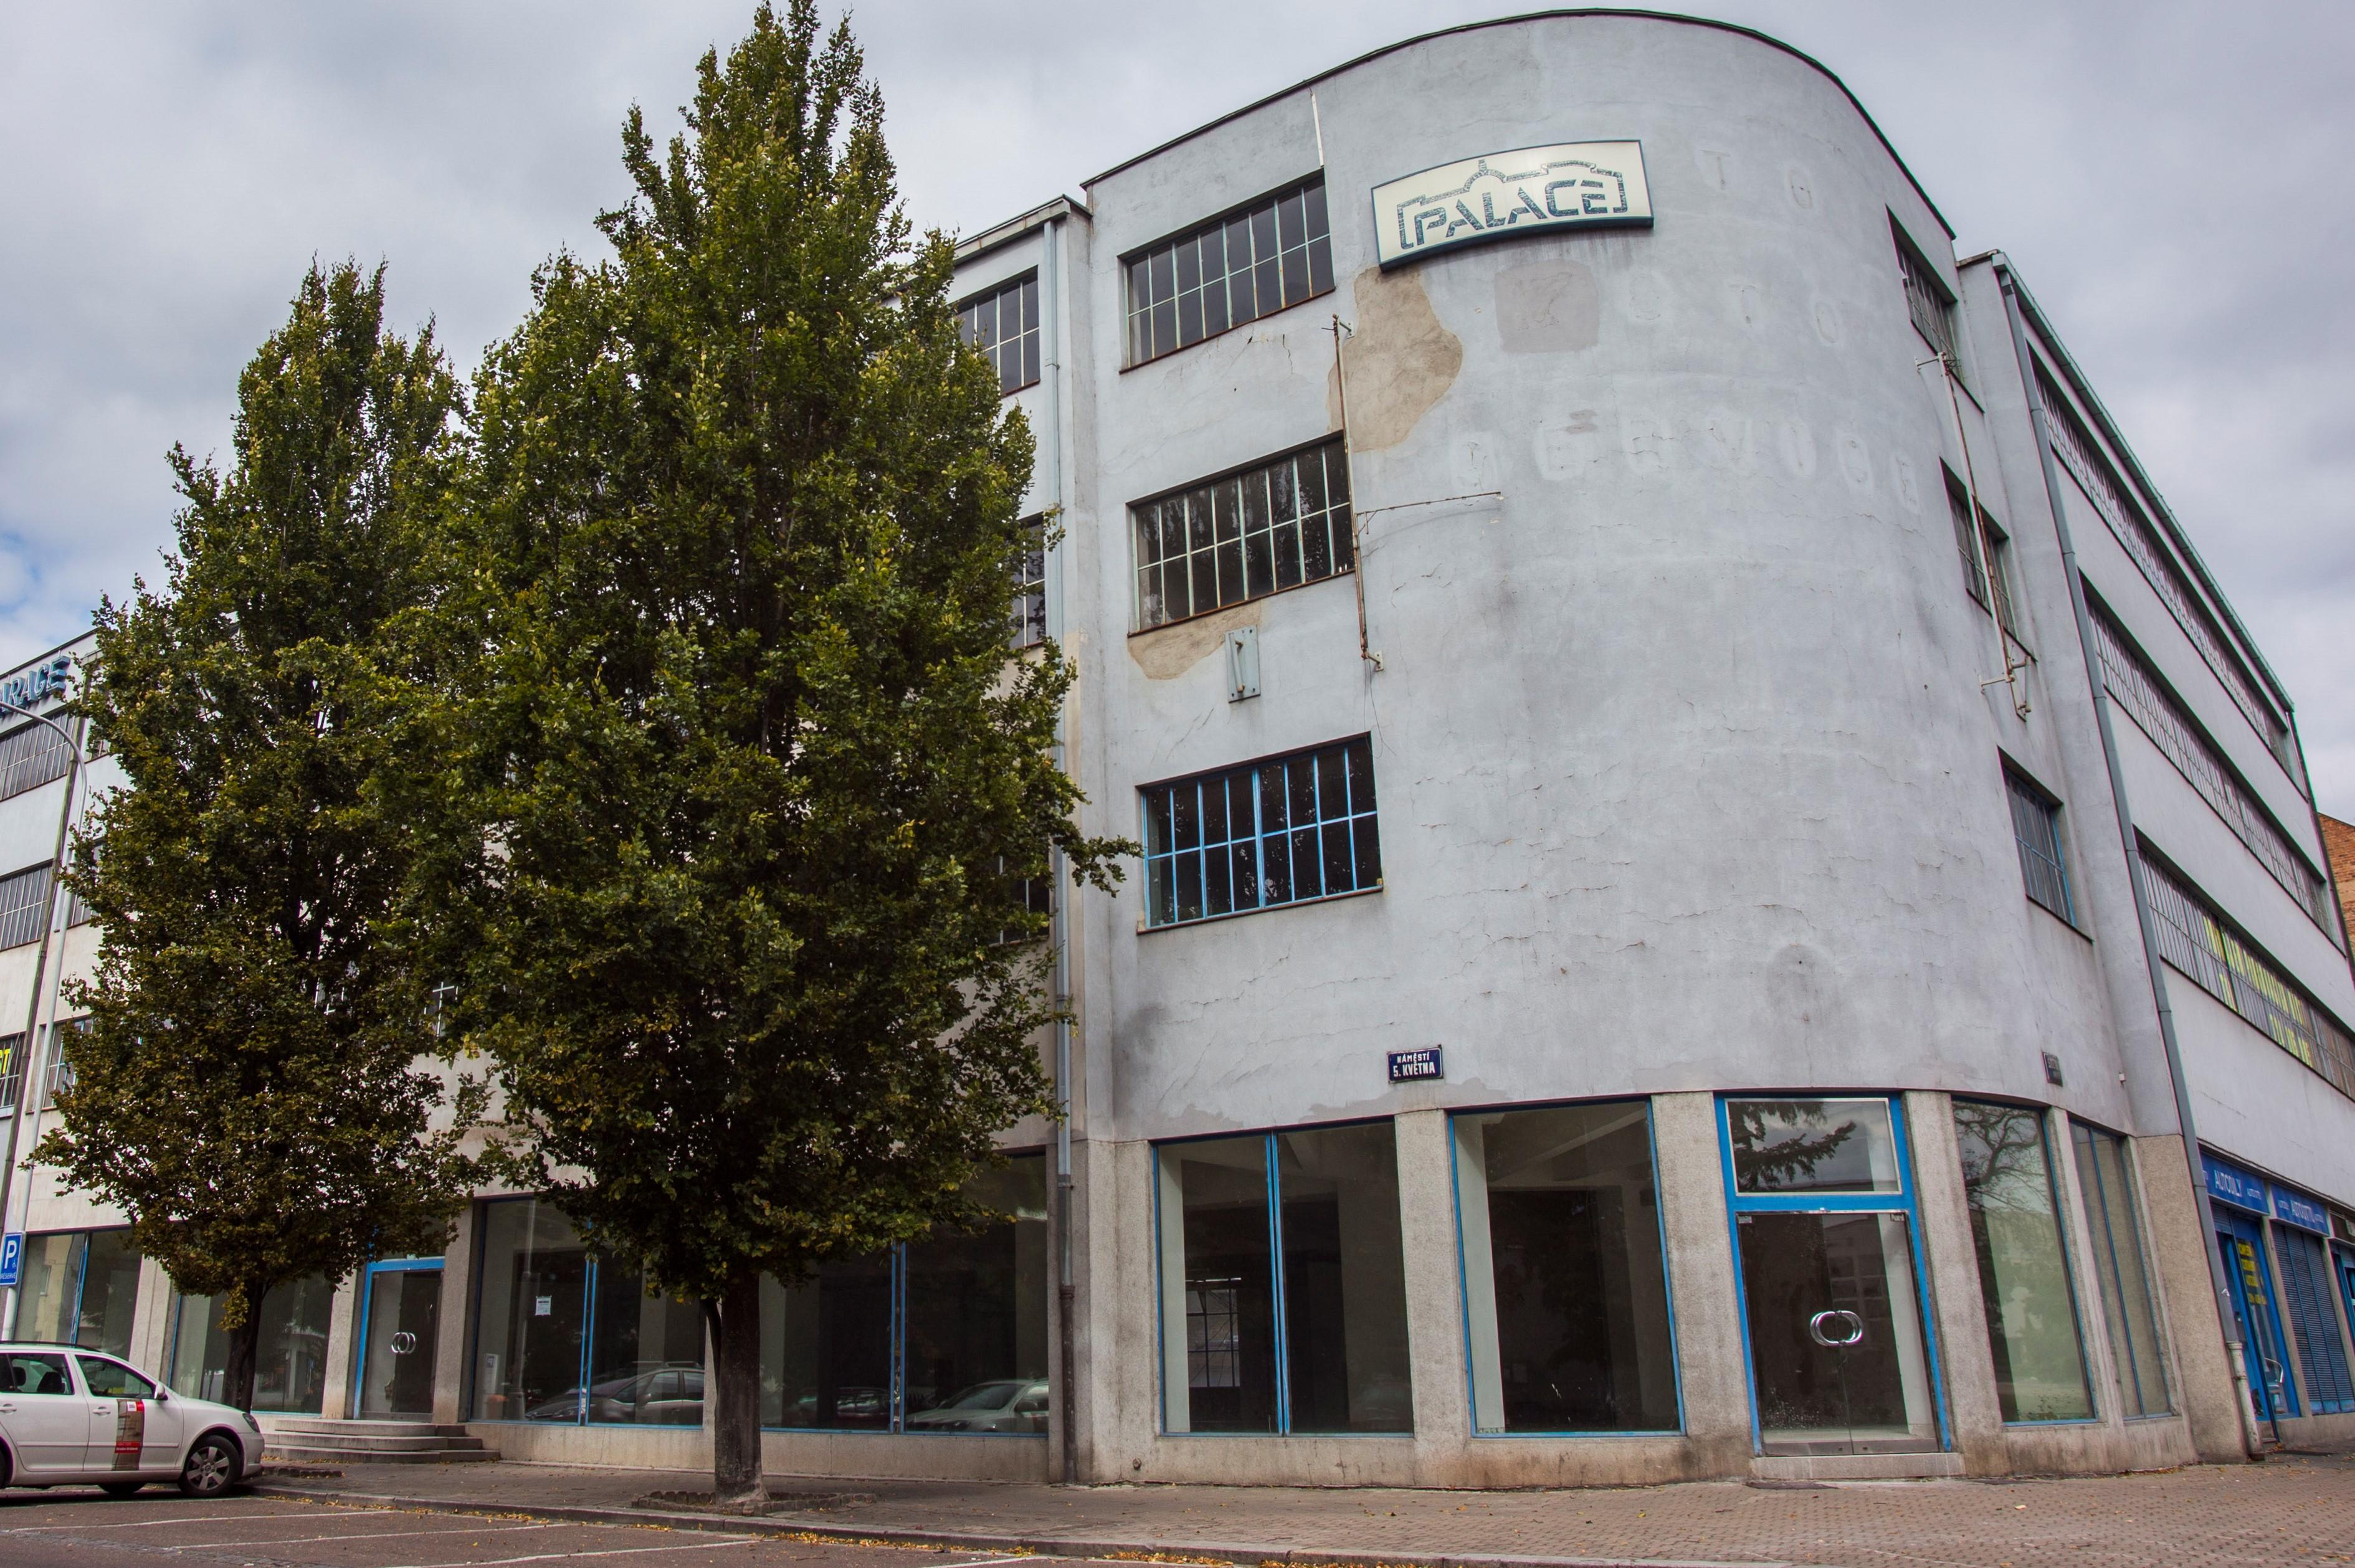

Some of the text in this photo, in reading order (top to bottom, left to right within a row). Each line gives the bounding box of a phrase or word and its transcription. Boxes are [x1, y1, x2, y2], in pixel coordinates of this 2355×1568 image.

[1414, 179, 1608, 245] PALACE
[1392, 1061, 1435, 1077] 5. KVĚTNA
[1397, 1052, 1430, 1063] NÁMĚSTÍ
[4, 1240, 17, 1270] P
